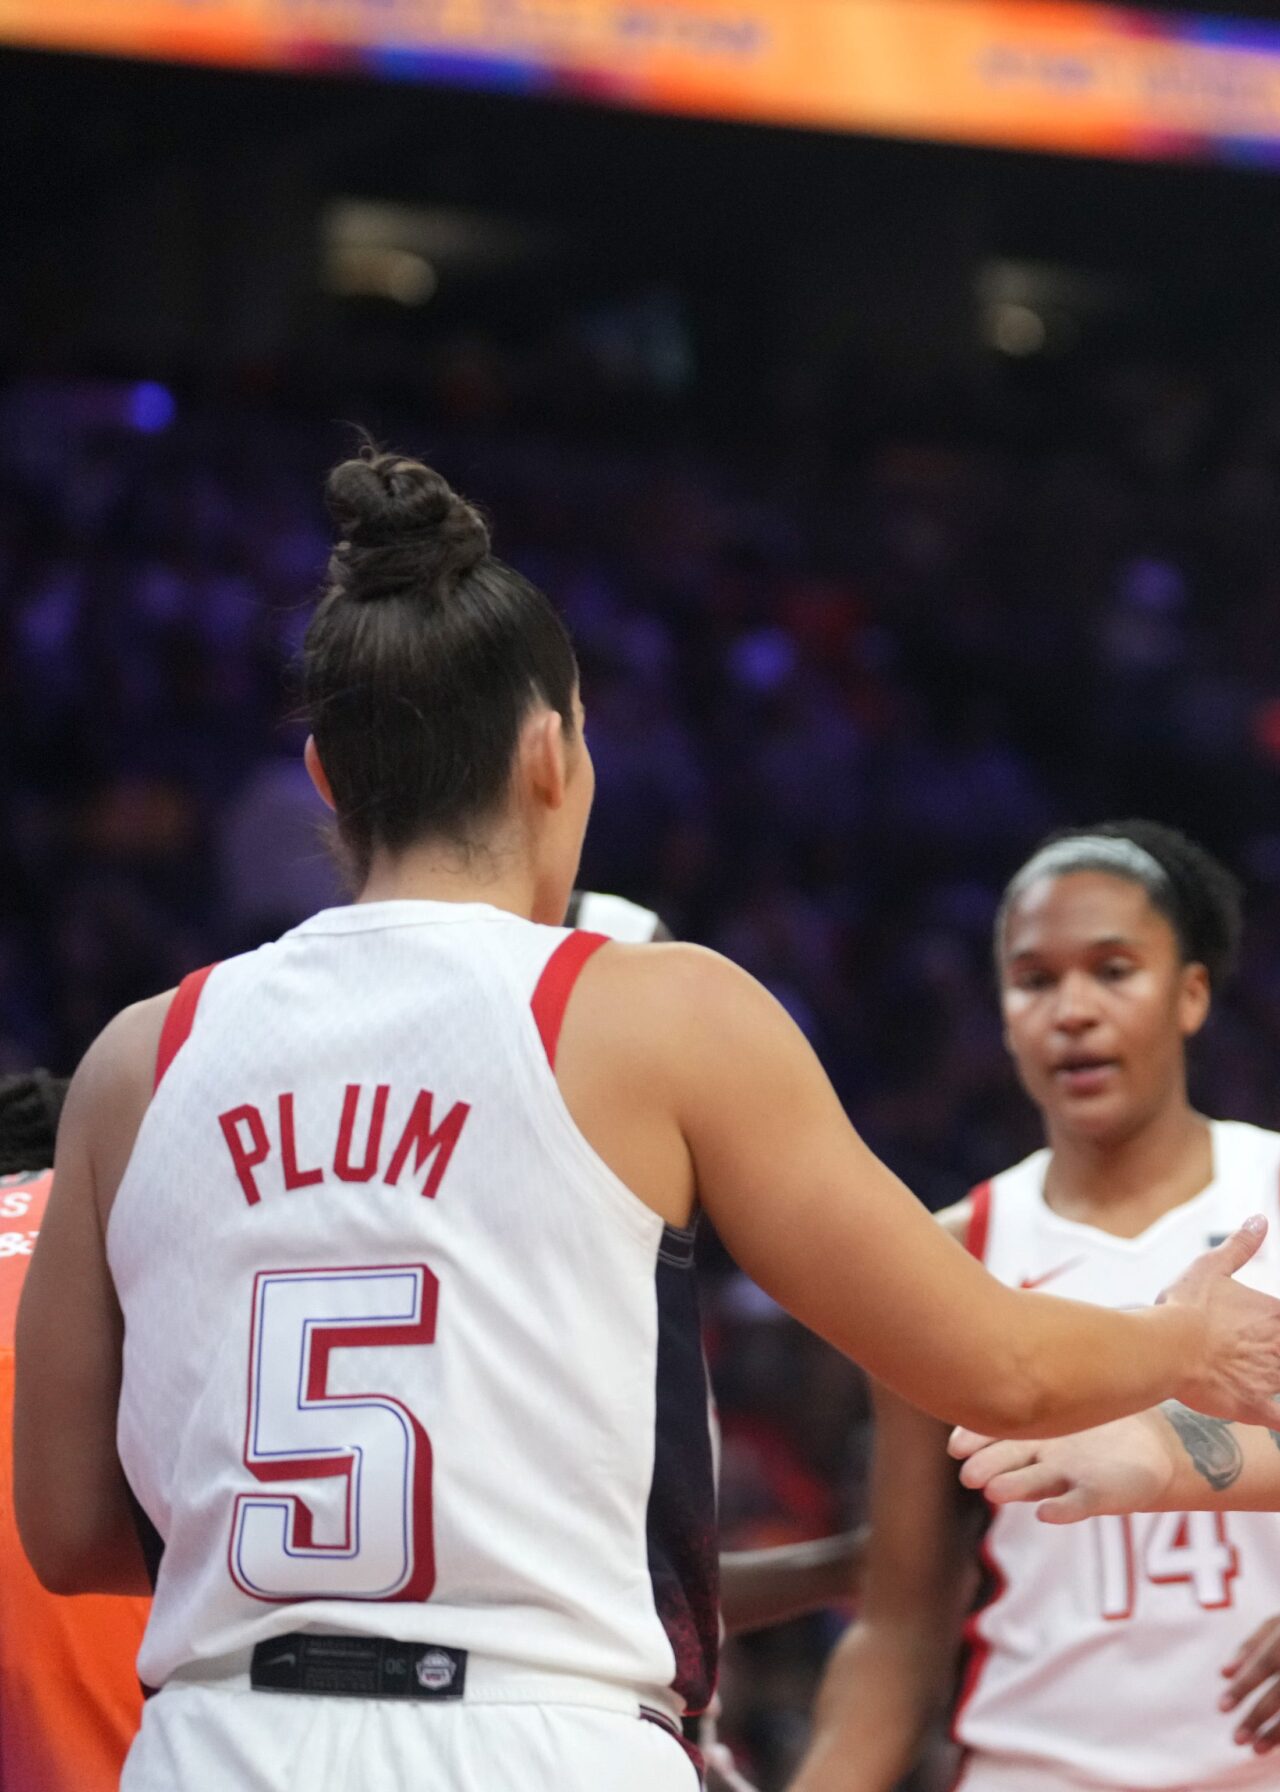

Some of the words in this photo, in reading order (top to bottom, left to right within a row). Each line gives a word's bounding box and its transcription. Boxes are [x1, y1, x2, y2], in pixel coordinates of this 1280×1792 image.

[218, 1084, 471, 1207] PLUM
[228, 1264, 439, 1603] 5
[1092, 1511, 1240, 1621] 14
